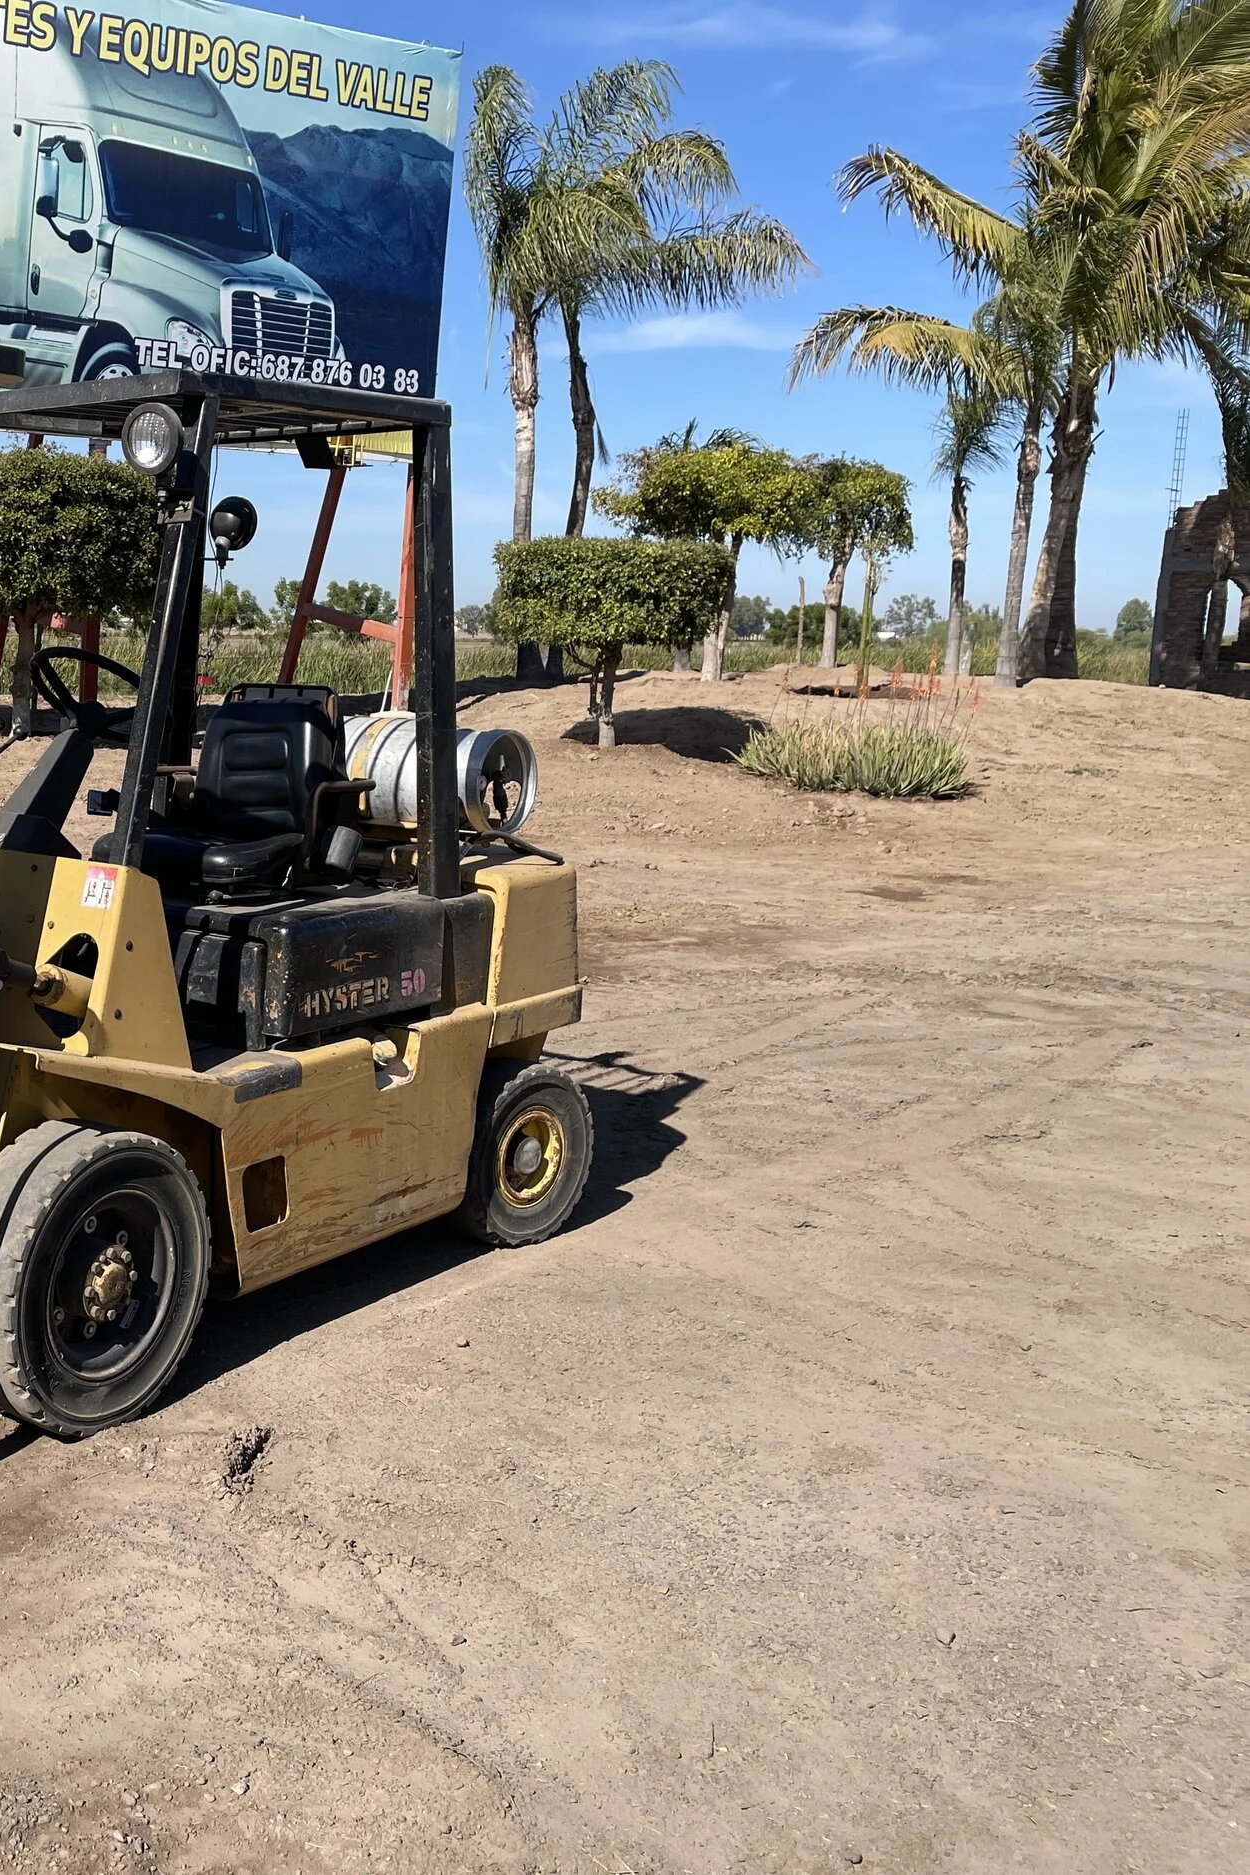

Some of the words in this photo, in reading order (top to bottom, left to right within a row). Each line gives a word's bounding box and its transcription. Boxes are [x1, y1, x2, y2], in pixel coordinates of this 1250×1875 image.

[64, 6, 96, 57] Y
[98, 13, 260, 88] EQUIPOS
[265, 46, 329, 102] DEL
[335, 58, 434, 122] VALLE
[134, 337, 183, 369] TEL
[310, 359, 353, 386] 876
[359, 363, 385, 390] 03
[393, 368, 419, 394] 83
[304, 975, 390, 1018] HYSTER
[401, 968, 426, 997] 50
